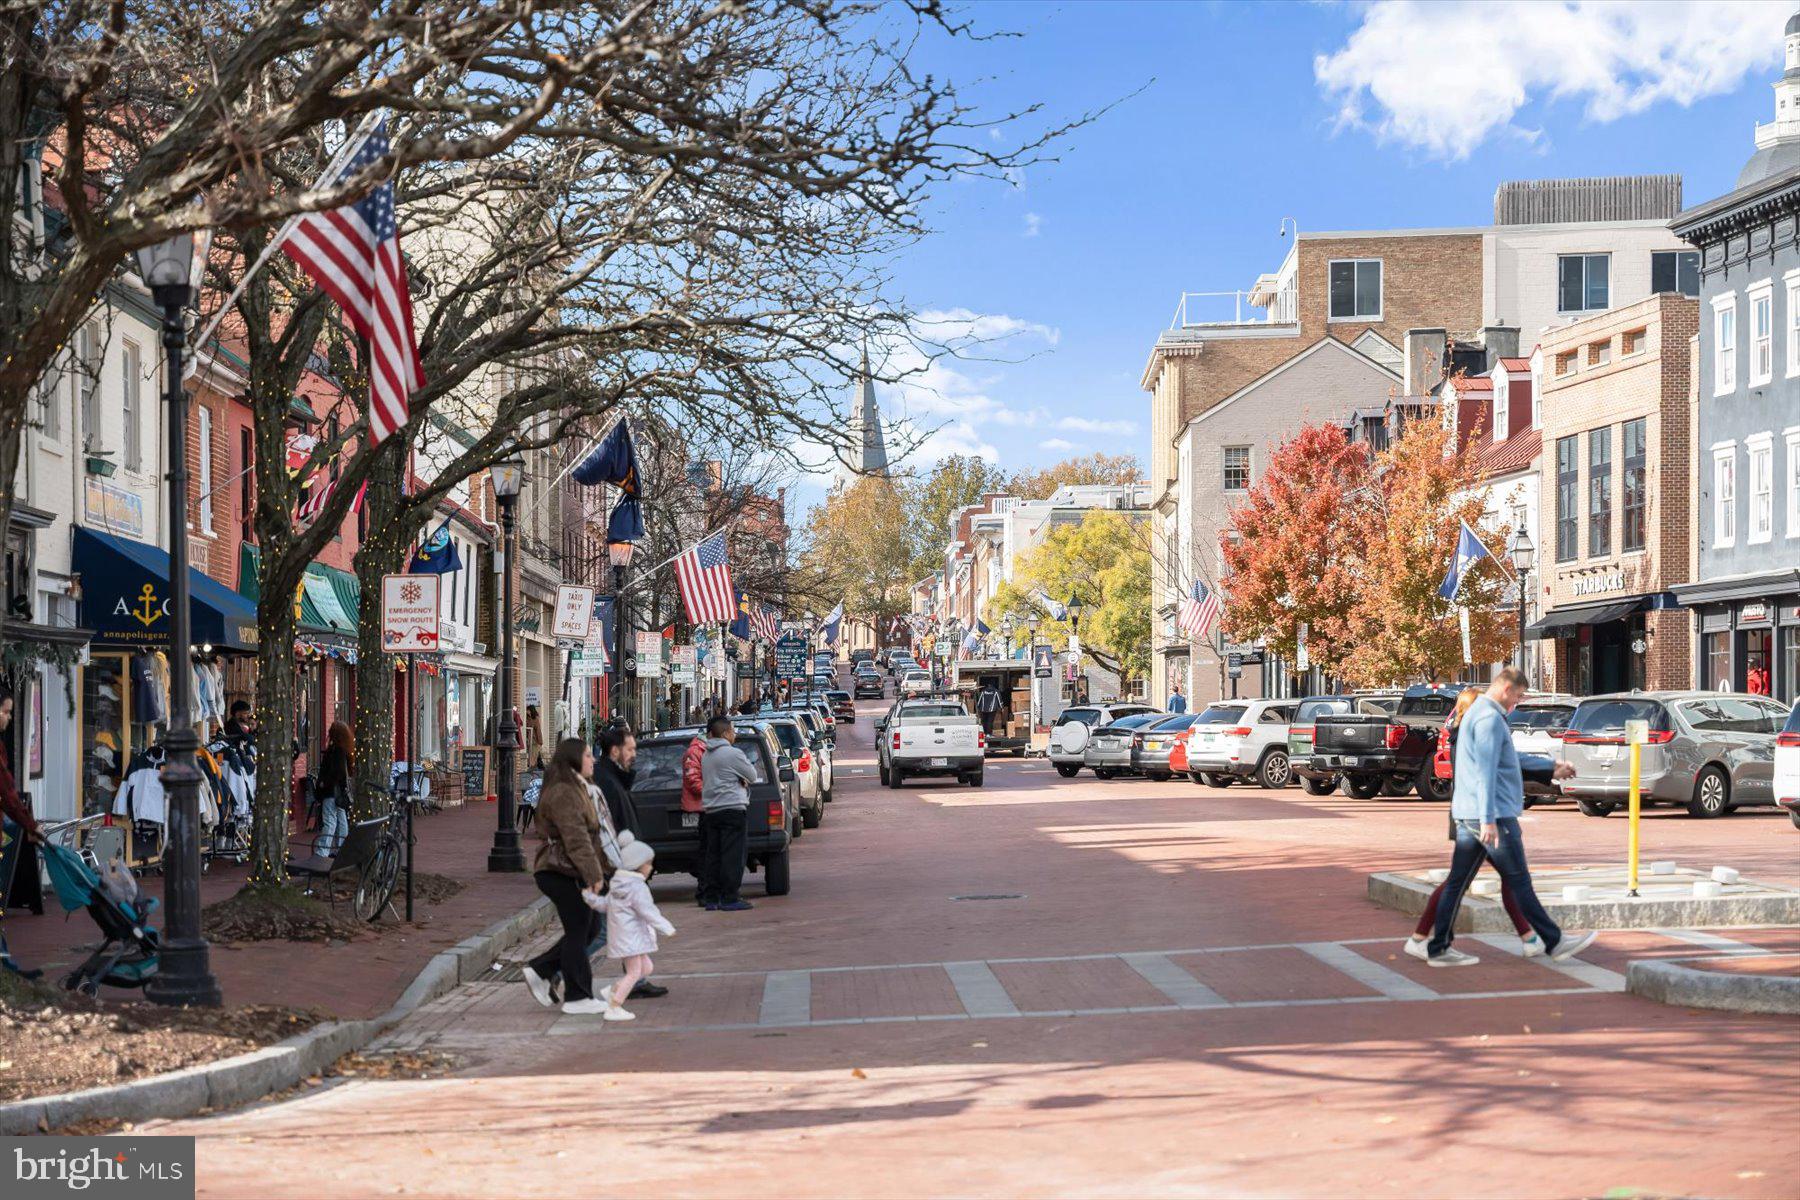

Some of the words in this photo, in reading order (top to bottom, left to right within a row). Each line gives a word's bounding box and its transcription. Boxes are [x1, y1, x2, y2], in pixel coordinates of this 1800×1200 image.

[1573, 573, 1625, 596] STARBUCKS
[566, 602, 581, 610] ONLY
[571, 612, 575, 620] 2
[561, 621, 582, 630] SPACES
